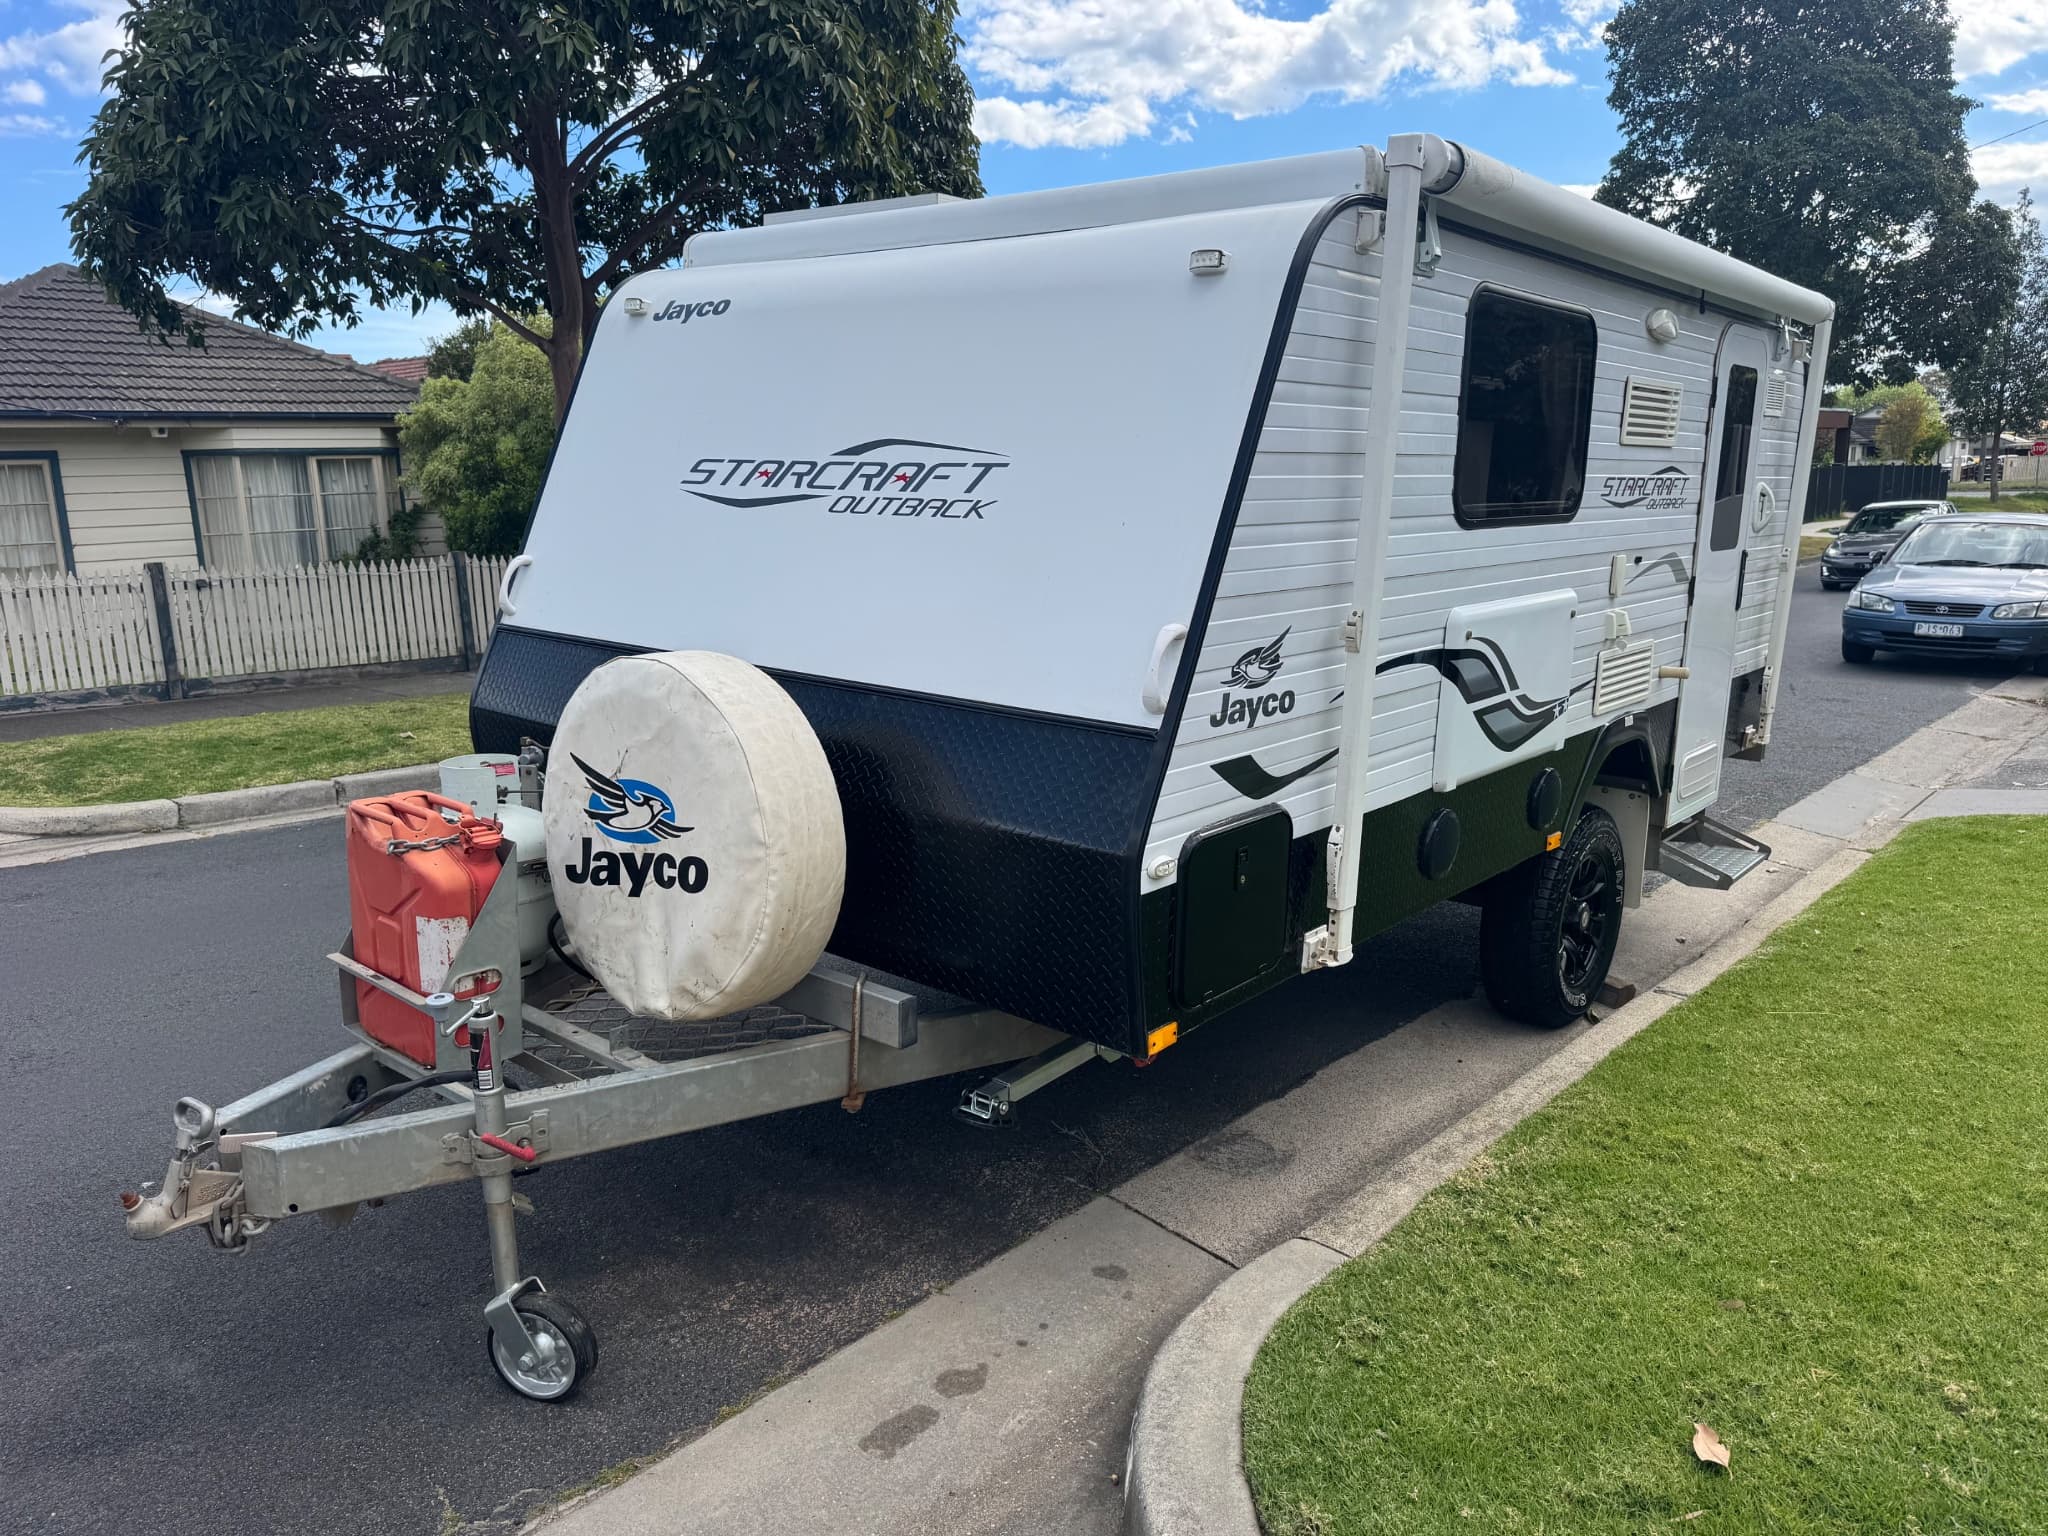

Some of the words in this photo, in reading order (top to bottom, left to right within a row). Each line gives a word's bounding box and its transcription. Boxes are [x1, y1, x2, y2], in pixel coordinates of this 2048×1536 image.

[652, 299, 732, 324] Jayco
[680, 457, 1011, 494] STARCRAFT
[1601, 477, 1690, 496] STARCRAFT
[827, 495, 999, 520] OUTBACK
[1645, 497, 1688, 510] OUTBACK
[1210, 690, 1295, 728] Jayco
[565, 837, 709, 898] Jayco
